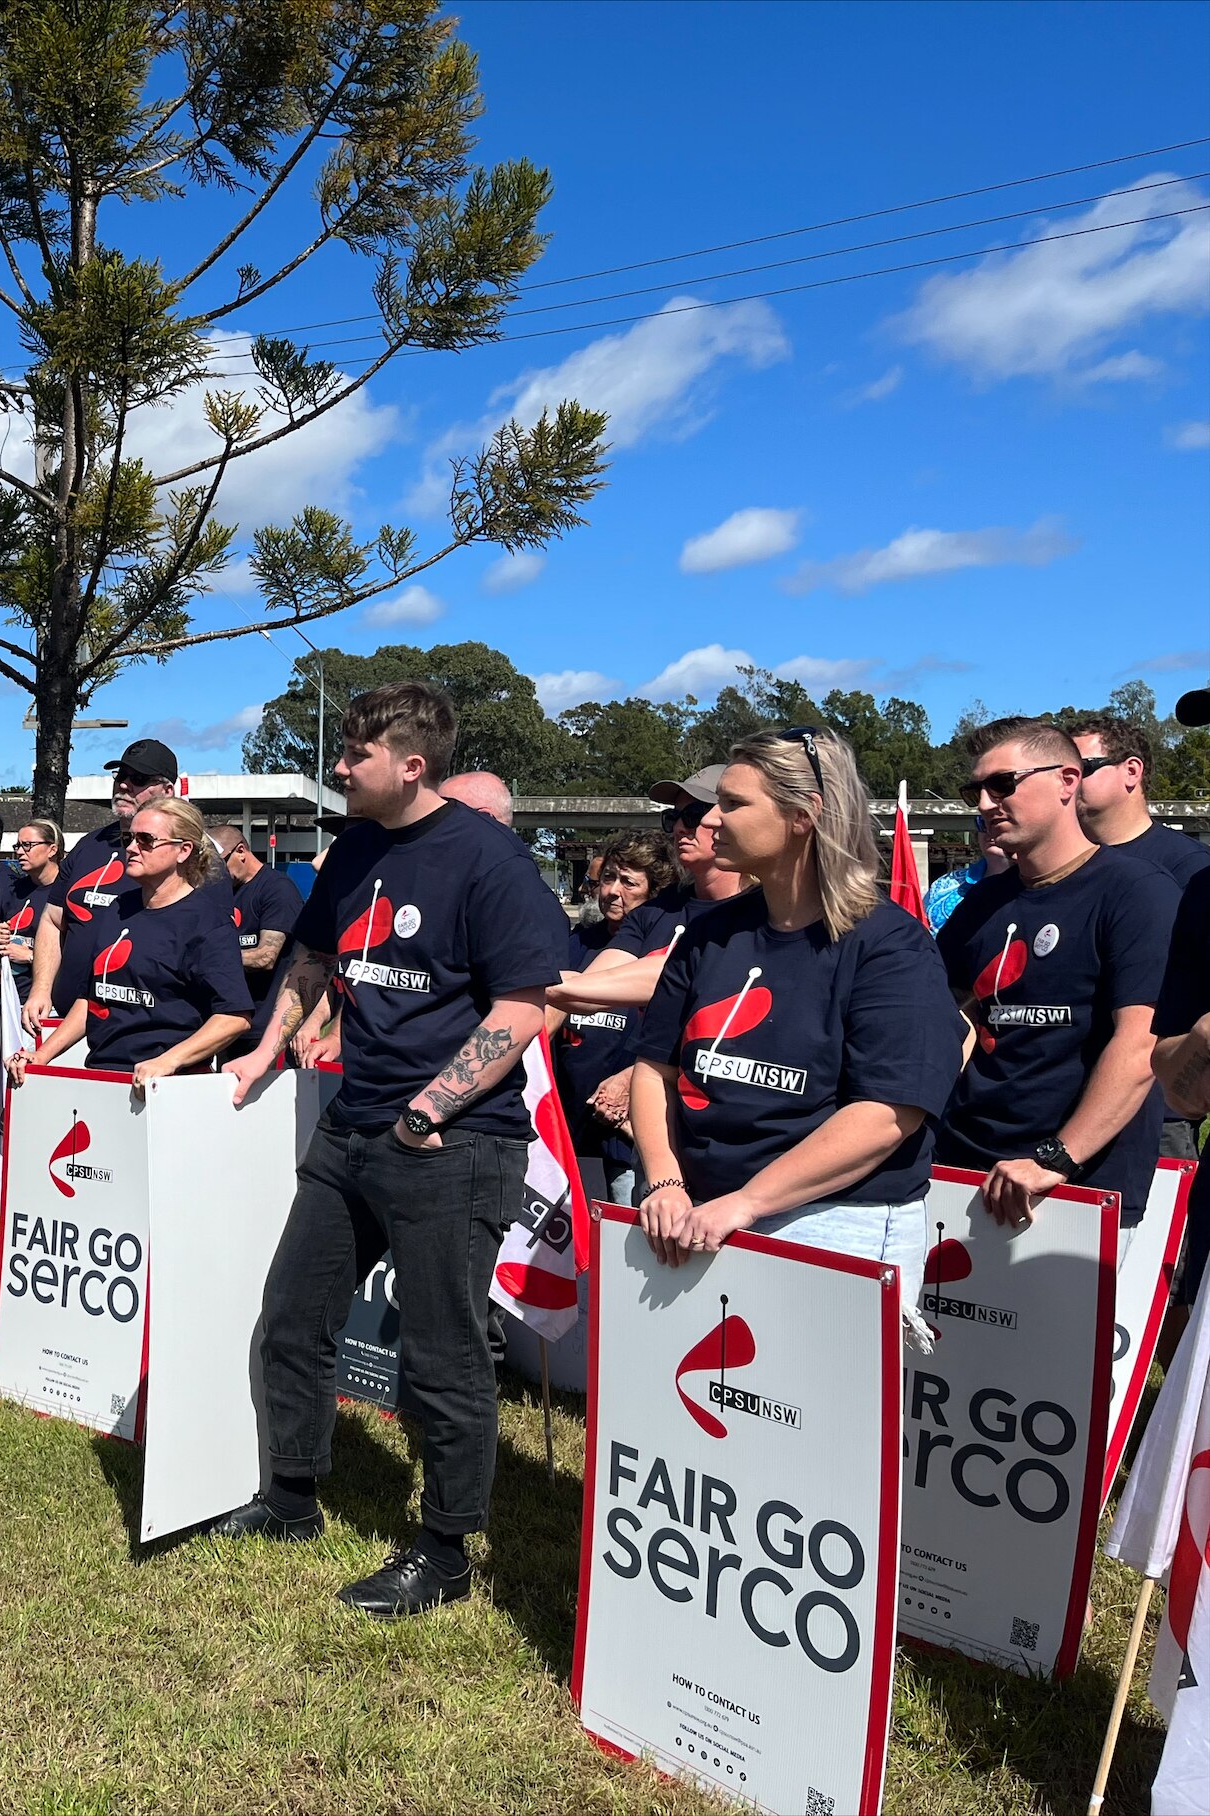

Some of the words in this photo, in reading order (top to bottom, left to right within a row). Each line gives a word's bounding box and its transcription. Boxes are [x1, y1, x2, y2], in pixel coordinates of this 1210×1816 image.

[349, 963, 426, 989] CPSUNSW
[572, 1014, 626, 1028] CPSUNS
[990, 1008, 1065, 1024] CPSUNSW
[697, 1054, 801, 1090] CPSUNSW
[67, 1165, 111, 1181] CPSUNSW
[11, 1211, 79, 1261] FAIR
[88, 1227, 142, 1273] GO
[925, 1297, 1012, 1326] CPSUNSW
[60, 1352, 81, 1364] CONTACT
[81, 1358, 89, 1366] US
[345, 1337, 357, 1347] HOW
[358, 1341, 365, 1349] TO
[365, 1343, 388, 1356] CONTACT
[389, 1350, 397, 1358] US
[711, 1385, 797, 1426] CPSUNSW
[969, 1387, 1077, 1456] GO
[608, 1440, 737, 1545] FAIR
[756, 1499, 866, 1590] GO
[914, 1548, 953, 1567] CONTACT
[955, 1561, 967, 1572] US
[672, 1673, 693, 1690] HOW
[694, 1684, 705, 1697] TO
[707, 1691, 747, 1718] CONTACT
[748, 1711, 760, 1725] US
[679, 1722, 697, 1736] FOLLOW
[697, 1732, 705, 1741] US
[705, 1736, 712, 1745] ON
[712, 1740, 729, 1754] SOCIAL
[730, 1750, 746, 1763] MEDIA
